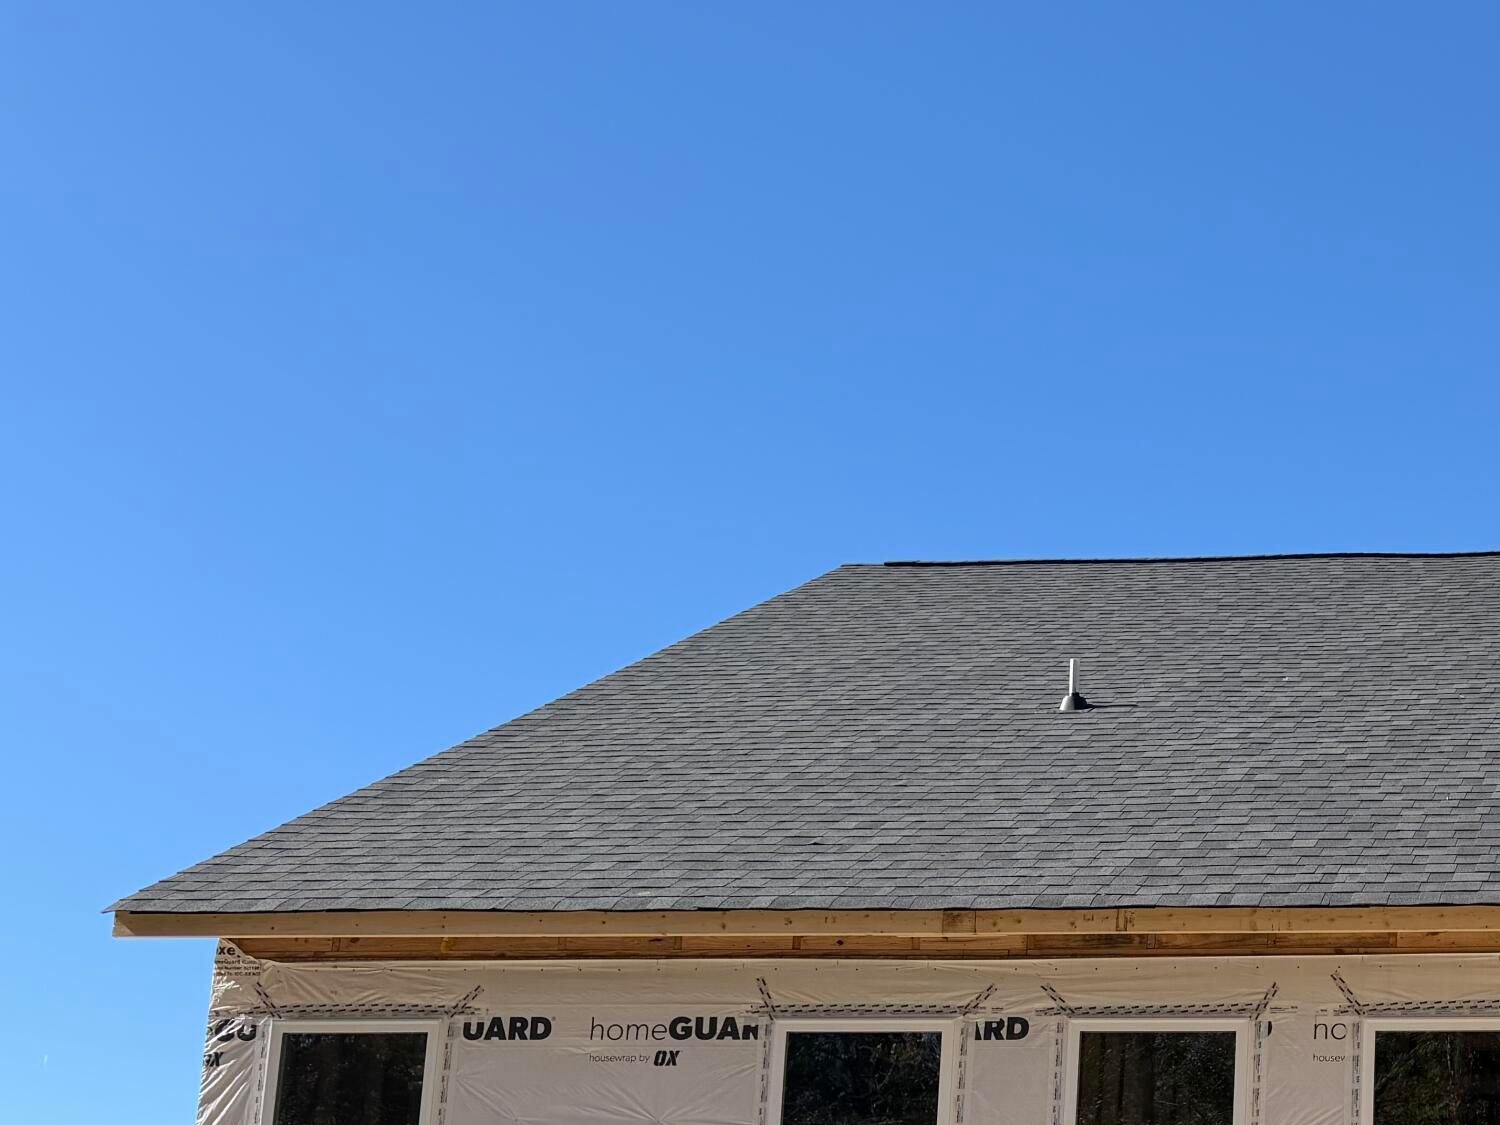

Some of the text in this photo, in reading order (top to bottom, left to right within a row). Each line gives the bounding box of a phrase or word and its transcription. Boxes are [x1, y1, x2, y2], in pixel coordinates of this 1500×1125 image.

[589, 1050, 680, 1066] housewrap by OX
